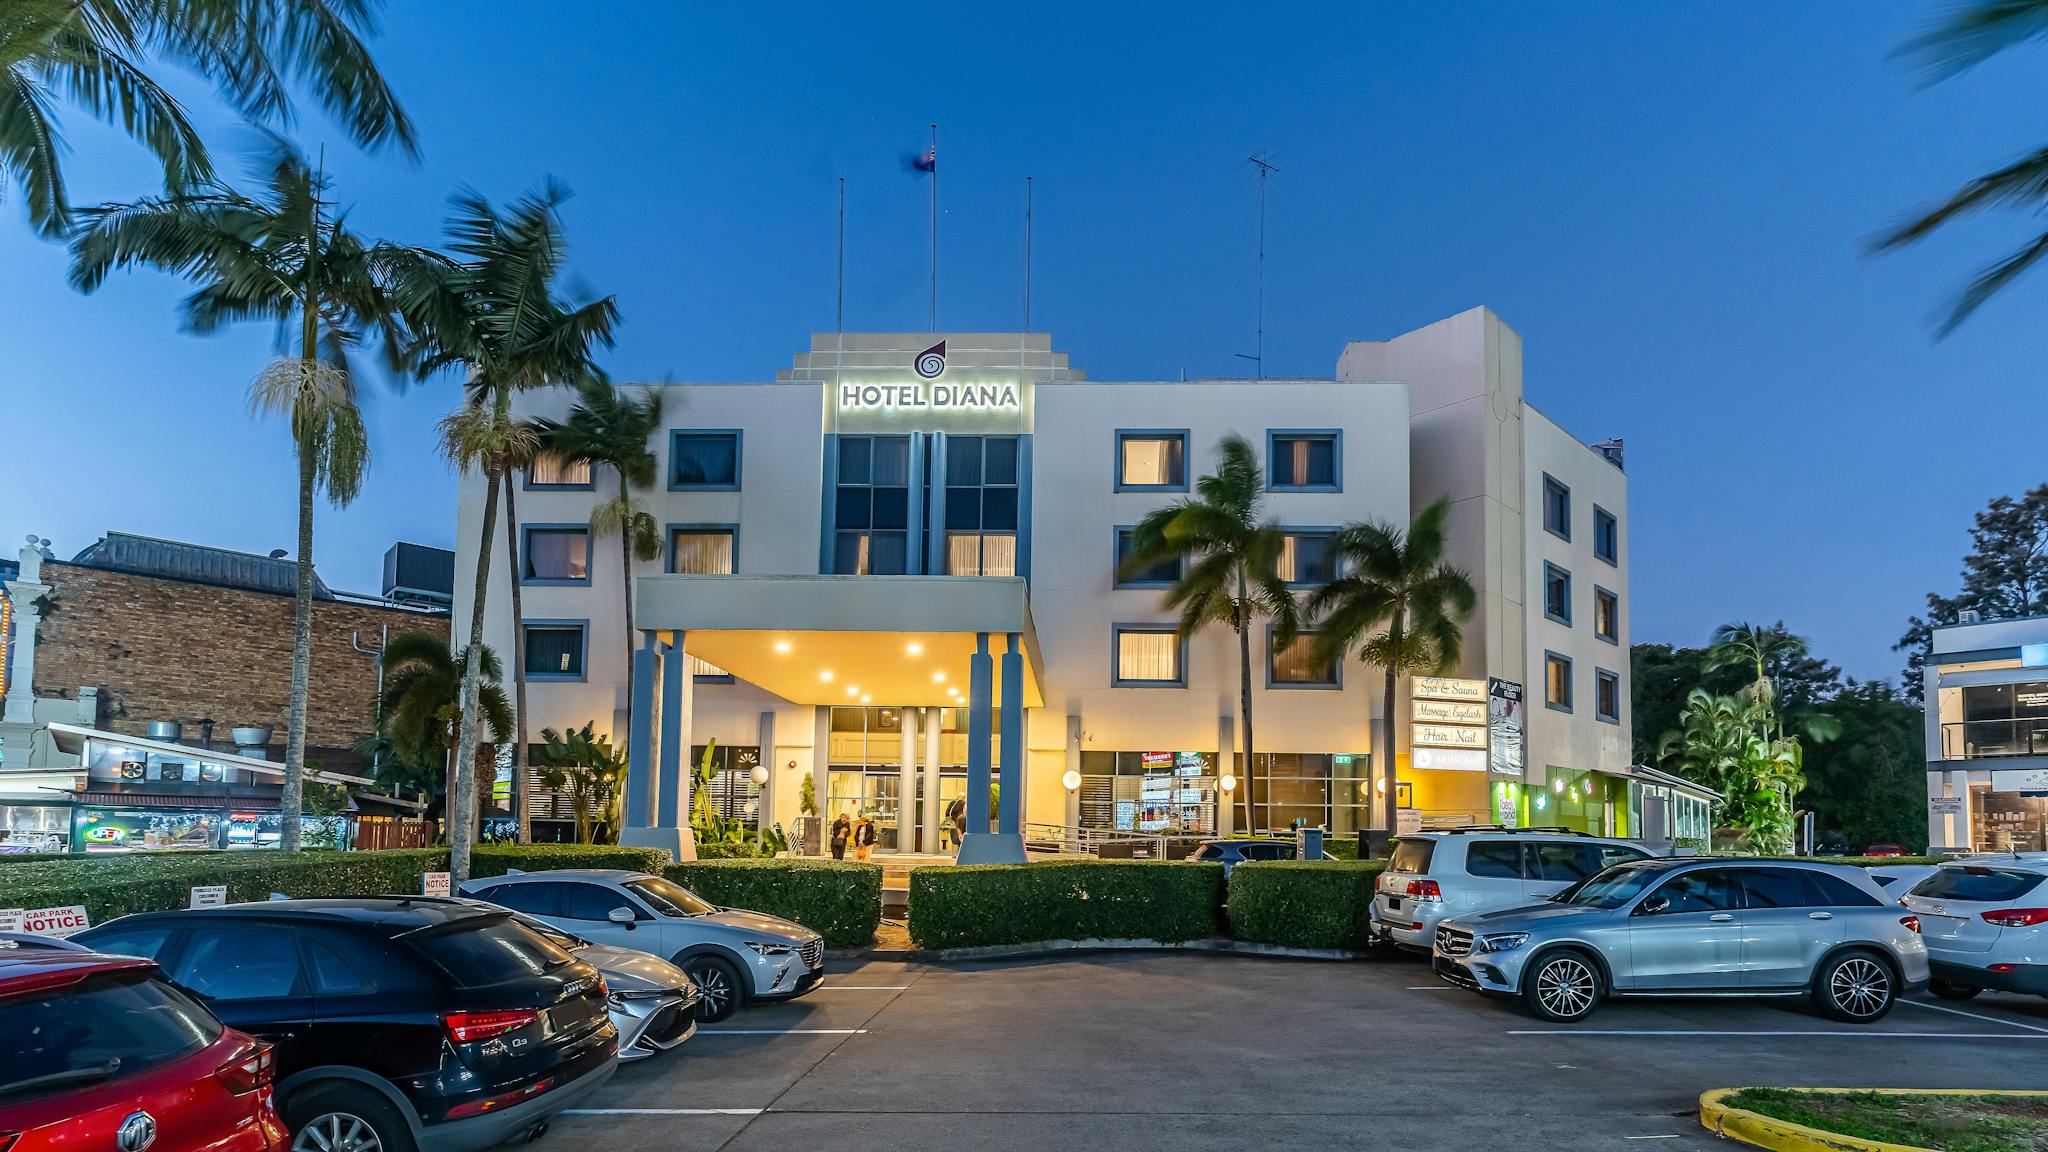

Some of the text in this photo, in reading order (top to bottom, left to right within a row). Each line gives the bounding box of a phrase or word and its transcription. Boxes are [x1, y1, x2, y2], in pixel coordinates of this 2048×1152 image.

[842, 384, 1018, 406] HOTEL DIANA
[1420, 681, 1479, 696] Spa & Sauna
[1417, 703, 1482, 720] Massage Eyelash
[1424, 728, 1477, 744] Hair Nail
[91, 829, 122, 841] OPEN
[425, 879, 449, 888] NOTICE
[26, 908, 75, 920] CAR PARK
[24, 915, 86, 932] NOTICE
[511, 1038, 528, 1048] Q3
